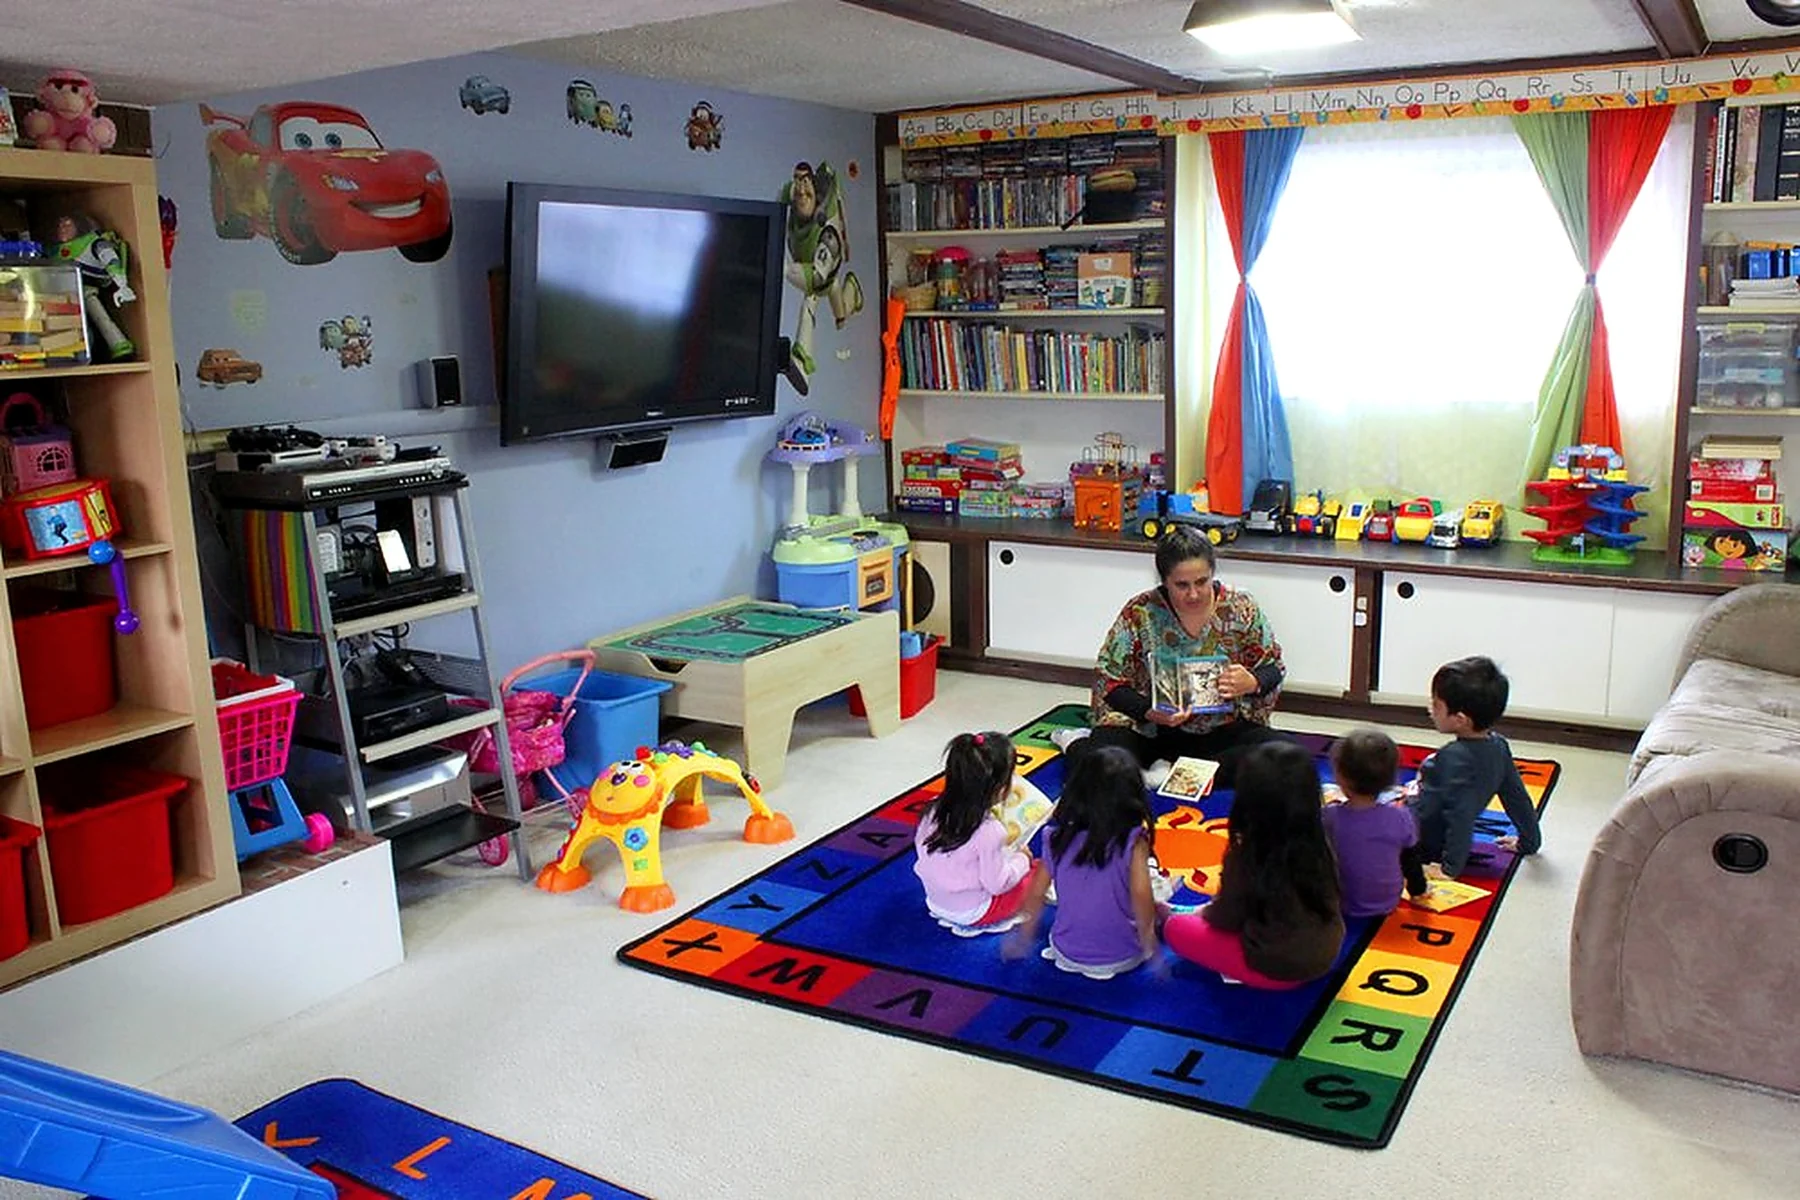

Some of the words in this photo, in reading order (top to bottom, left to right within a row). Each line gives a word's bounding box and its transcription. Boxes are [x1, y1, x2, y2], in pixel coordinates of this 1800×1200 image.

[1476, 79, 1510, 103] Qq
[1527, 76, 1551, 96] Rr
[1570, 73, 1594, 93] Ss
[1612, 69, 1633, 90] Tt
[1660, 65, 1691, 86] Uu
[1731, 58, 1760, 77] Vv
[1232, 97, 1256, 115] Kk
[1311, 91, 1348, 110] Mm
[1357, 88, 1385, 107] Nn
[1395, 85, 1425, 104] Oo
[1434, 82, 1461, 106] Pp
[904, 119, 925, 134] Aa
[935, 116, 955, 132] Bb
[962, 112, 984, 130] Cc
[993, 109, 1014, 127] Dd
[1028, 105, 1049, 123] Ee
[1125, 98, 1150, 115] Hh
[856, 832, 908, 849] A
[795, 859, 850, 881] Z
[725, 893, 785, 913] Y
[662, 931, 723, 959] X
[1399, 922, 1453, 948] P
[1359, 968, 1429, 997] Q
[1329, 1018, 1405, 1052] R
[878, 988, 934, 1019] V
[1008, 1015, 1070, 1049] U
[1151, 1049, 1207, 1087] T
[1303, 1073, 1371, 1113] S
[392, 1135, 452, 1181] L
